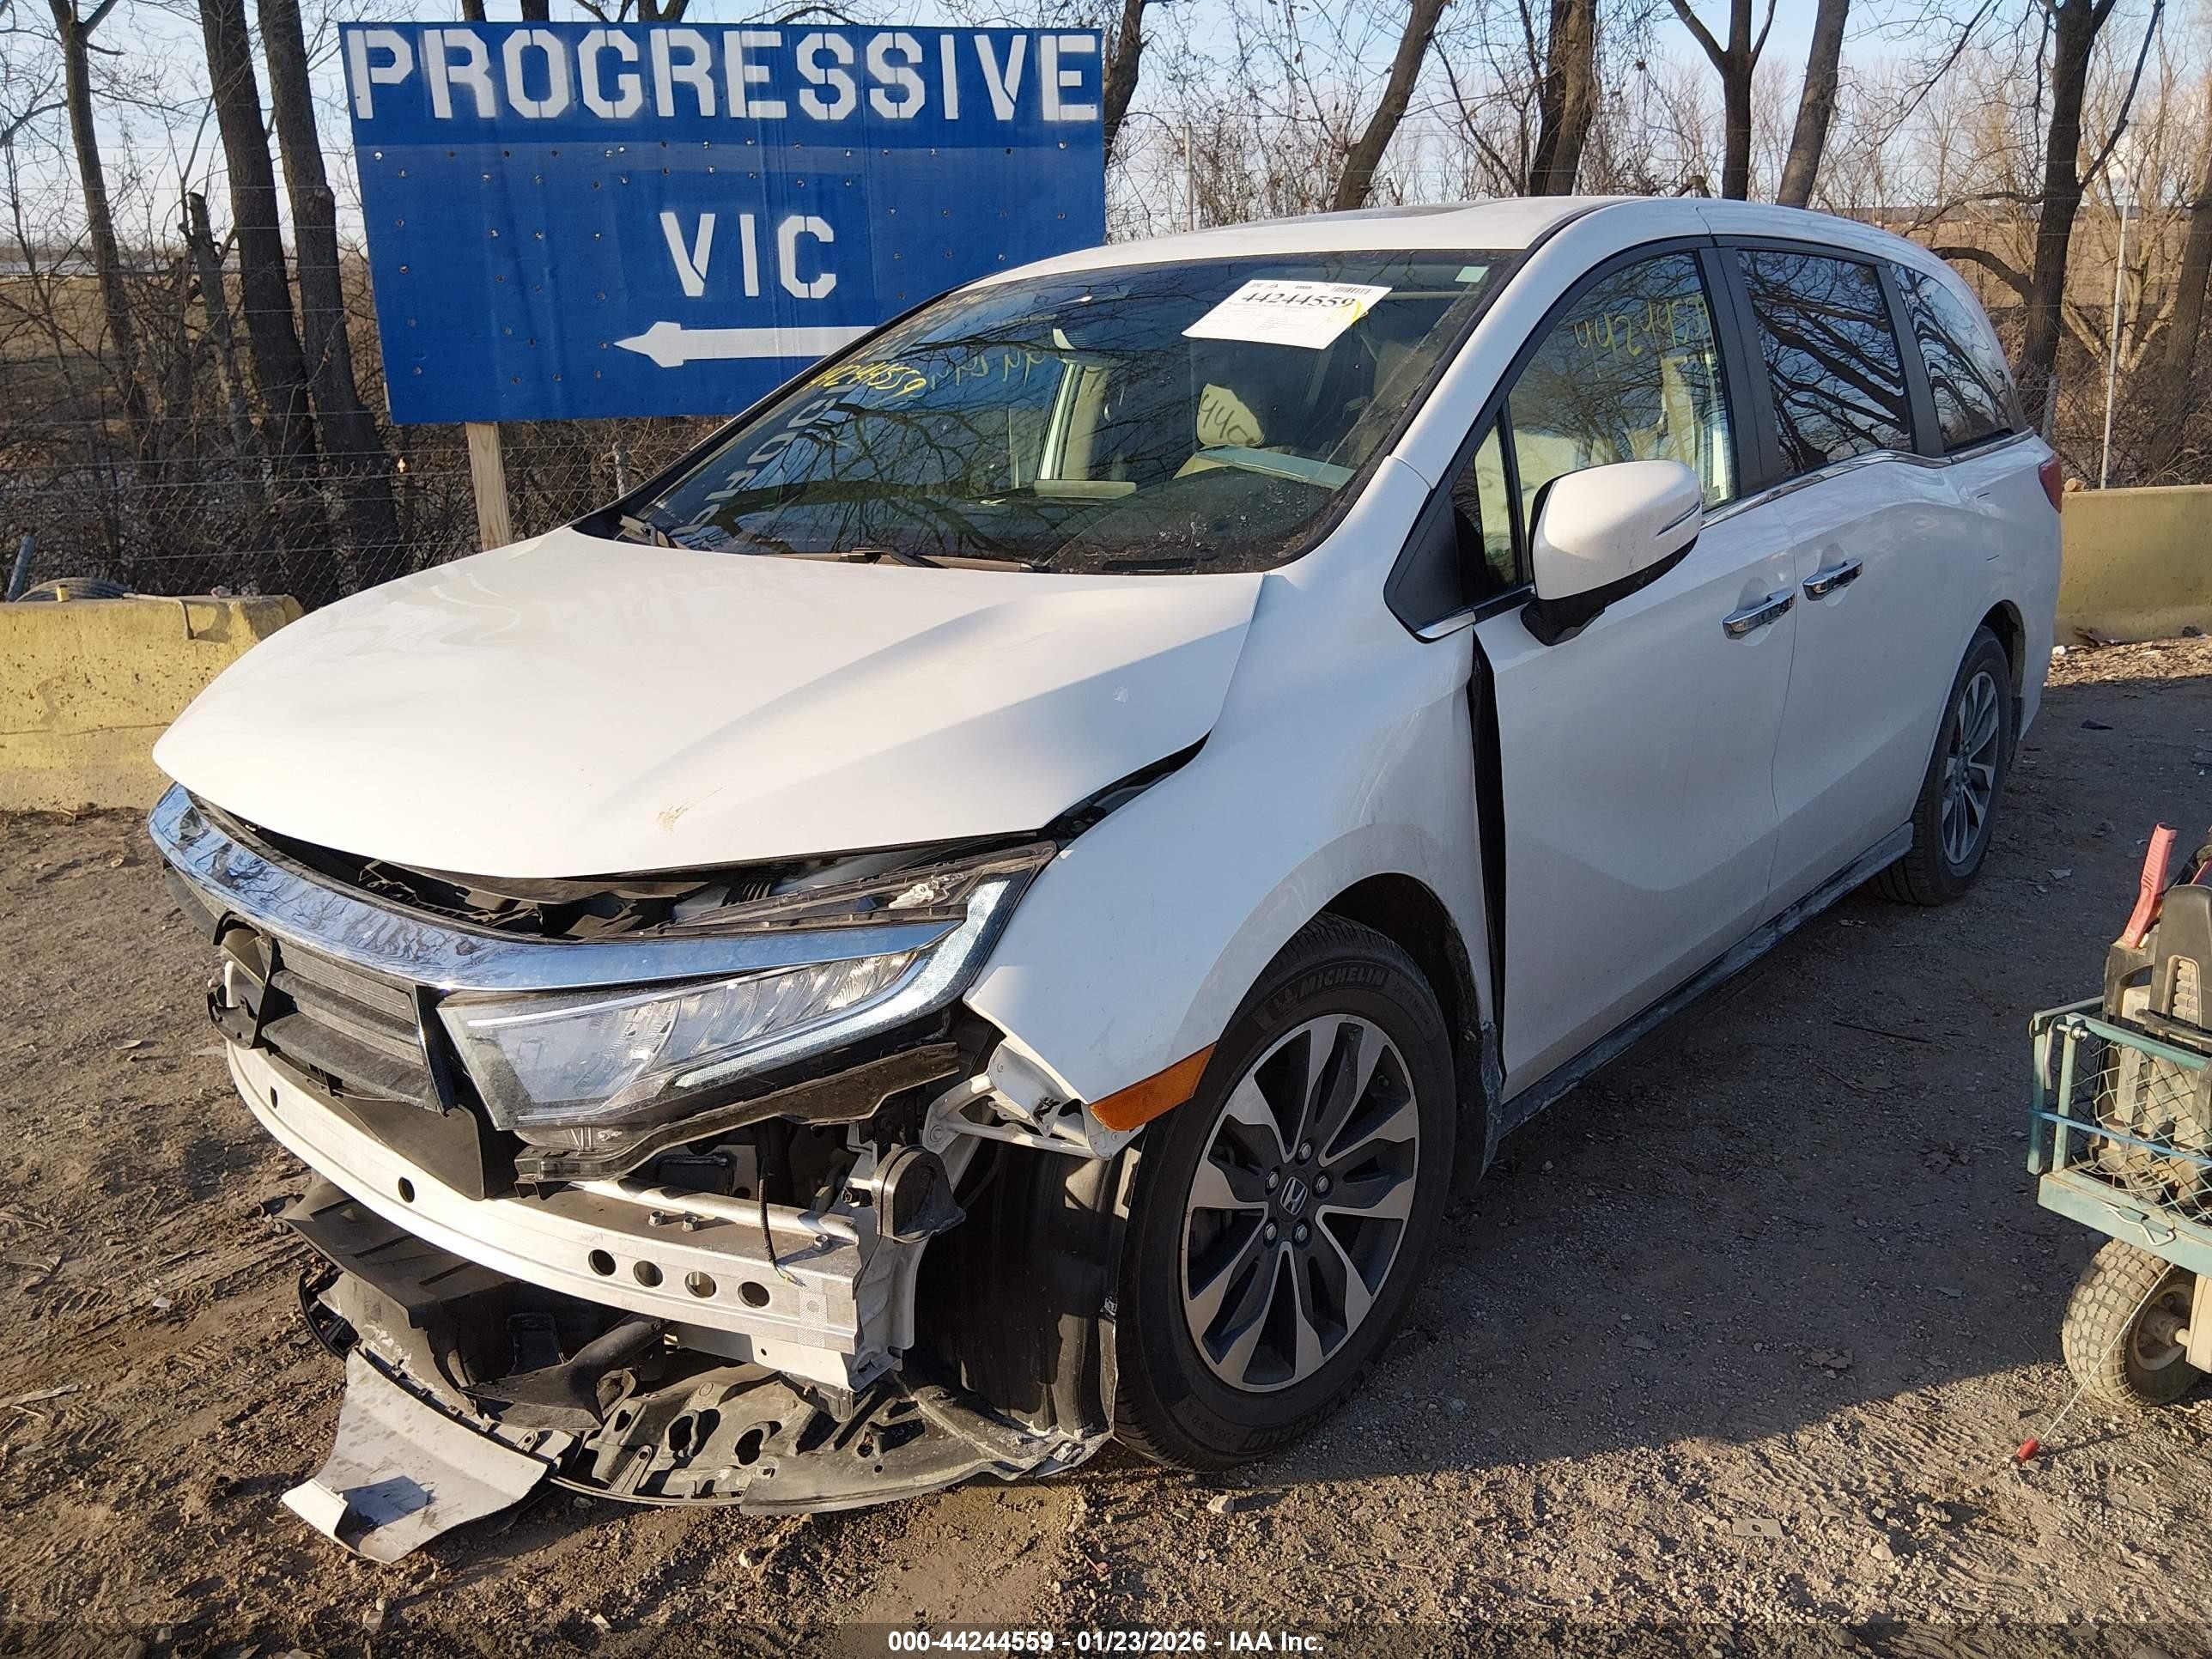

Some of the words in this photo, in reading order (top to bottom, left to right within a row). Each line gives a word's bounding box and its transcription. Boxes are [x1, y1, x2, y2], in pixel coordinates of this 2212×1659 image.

[354, 28, 1098, 122] PROGRESSIVE
[659, 211, 837, 300] VIC
[1242, 291, 1356, 308] 44244559
[1299, 967, 1386, 998] MICHELIN
